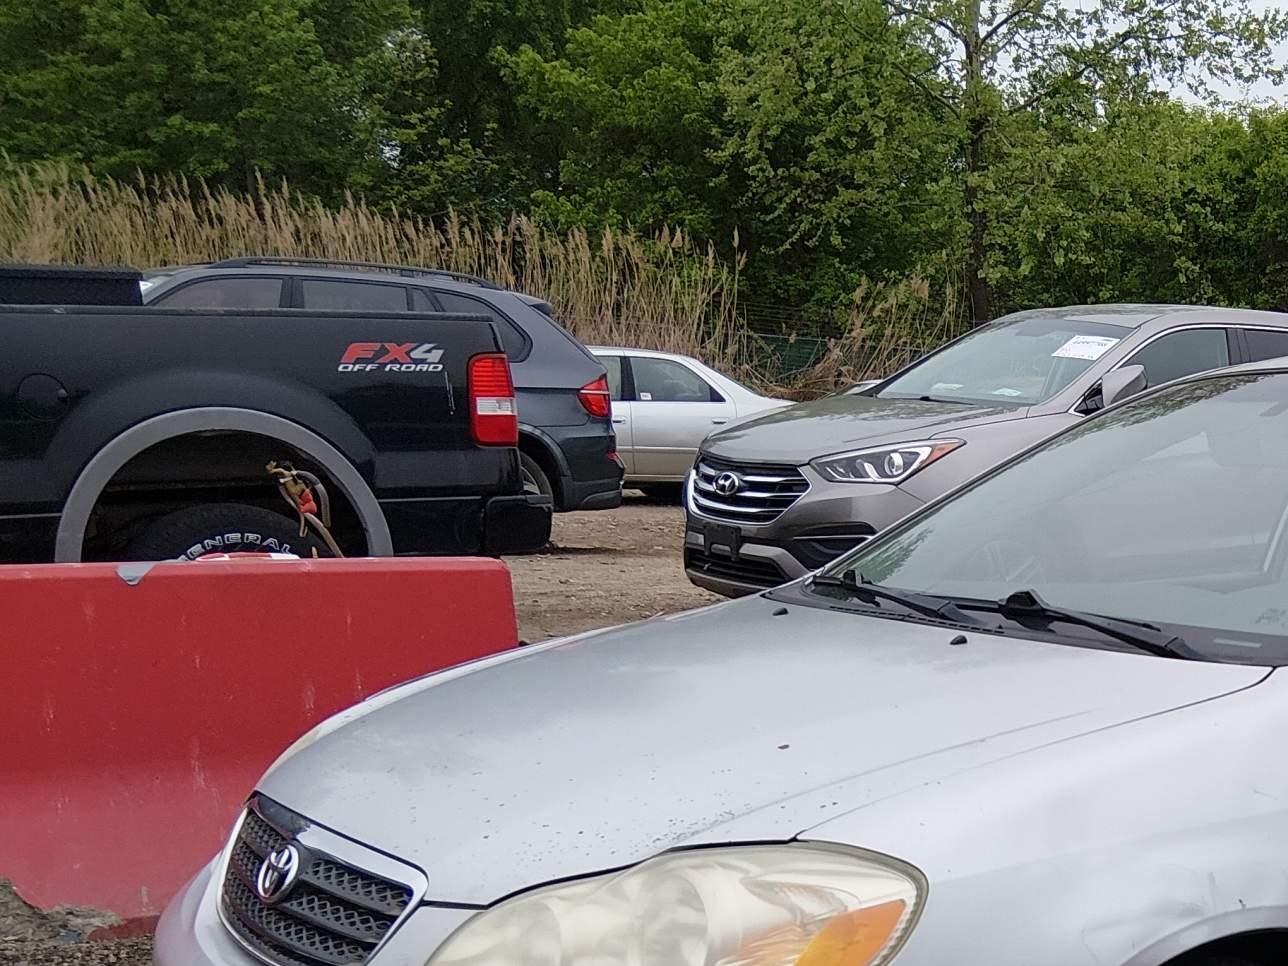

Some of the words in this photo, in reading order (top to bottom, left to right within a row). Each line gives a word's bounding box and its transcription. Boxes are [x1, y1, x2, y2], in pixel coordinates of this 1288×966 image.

[340, 342, 445, 363] FX4
[338, 364, 379, 372] OFF
[384, 364, 443, 372] ROAD
